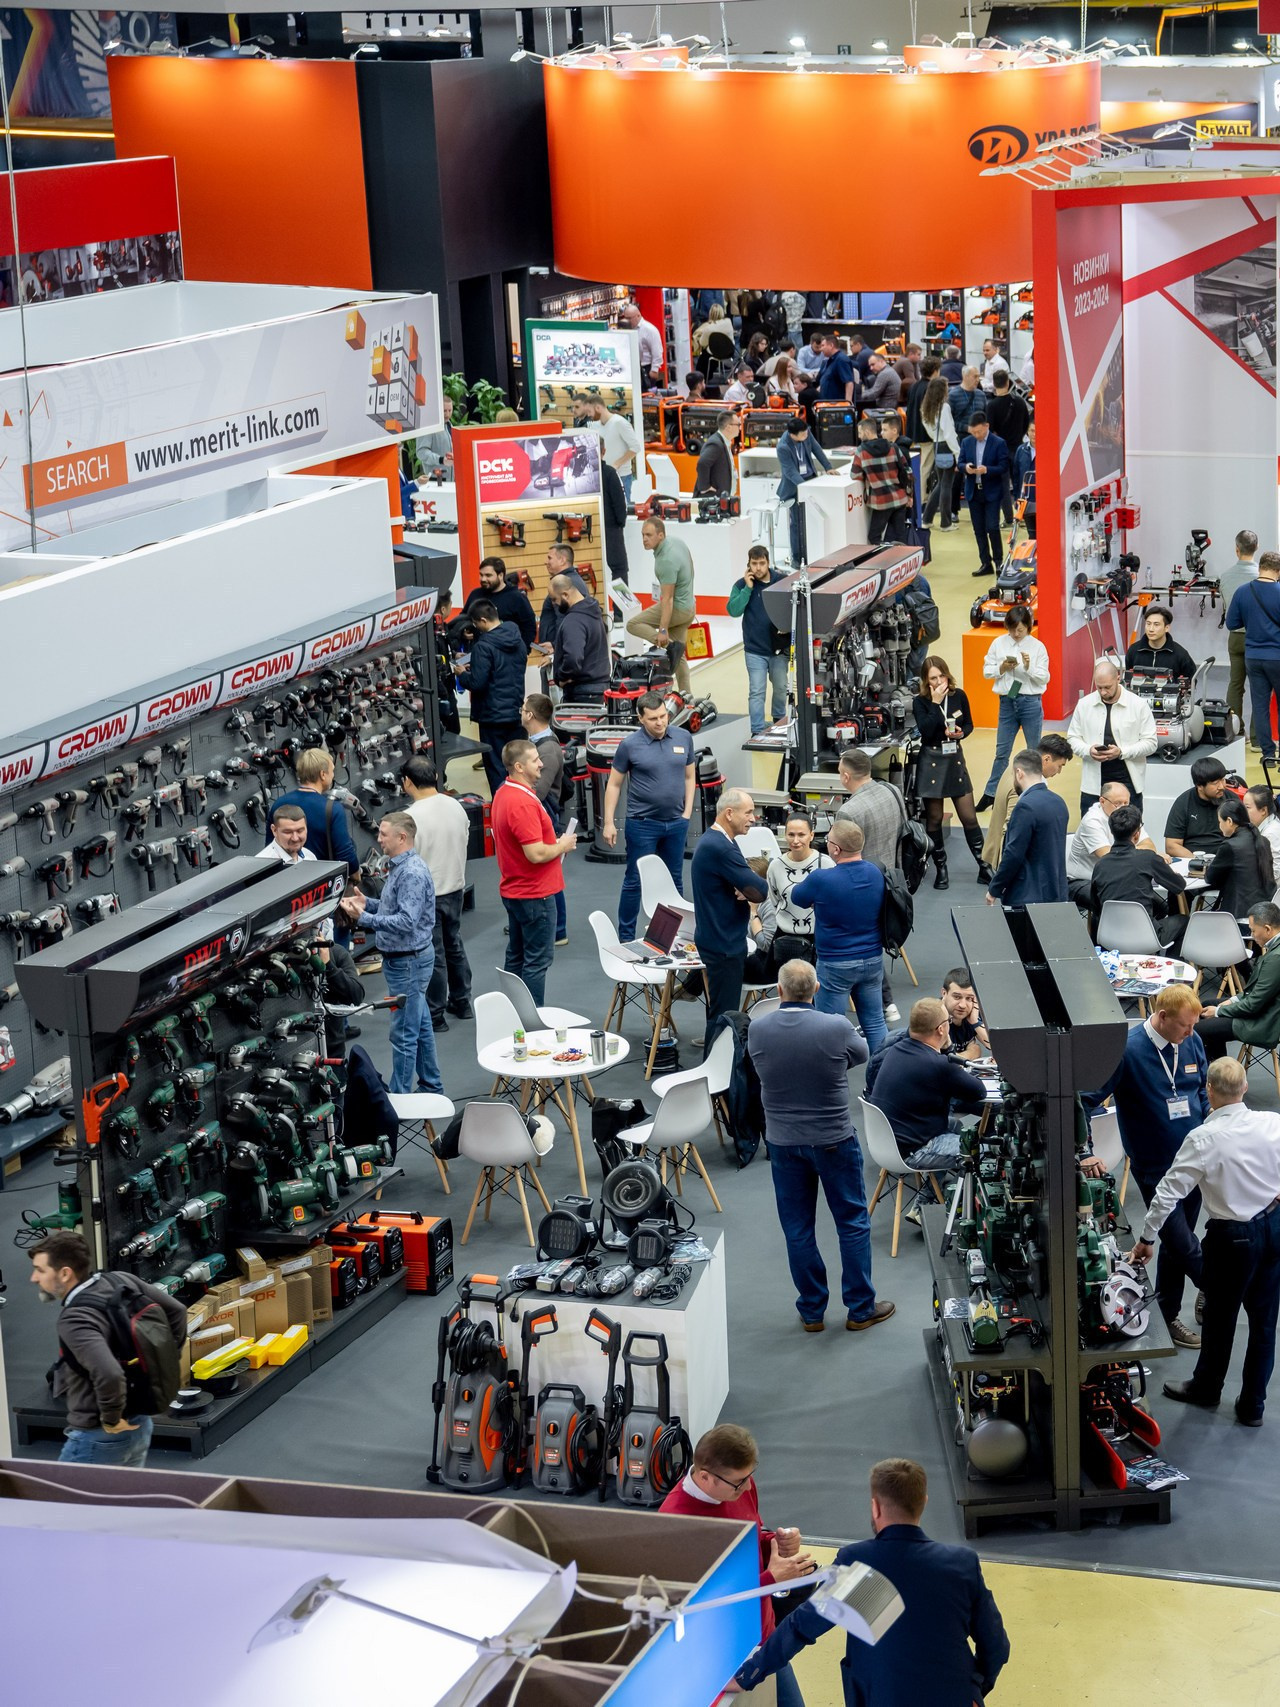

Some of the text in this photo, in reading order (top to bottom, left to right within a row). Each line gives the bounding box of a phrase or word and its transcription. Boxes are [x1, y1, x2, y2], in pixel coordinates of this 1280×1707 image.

[1073, 252, 1109, 286] НОВИНКИ
[1074, 283, 1109, 317] 2023-2024
[134, 405, 321, 473] www.merit-link.com
[46, 454, 110, 494] SEARCH
[479, 458, 514, 474] DCK
[381, 597, 431, 632] CROWN
[311, 624, 366, 660] CROWN
[231, 652, 294, 690] CROWN
[148, 681, 213, 723] CROWN
[58, 714, 128, 759] CROWN
